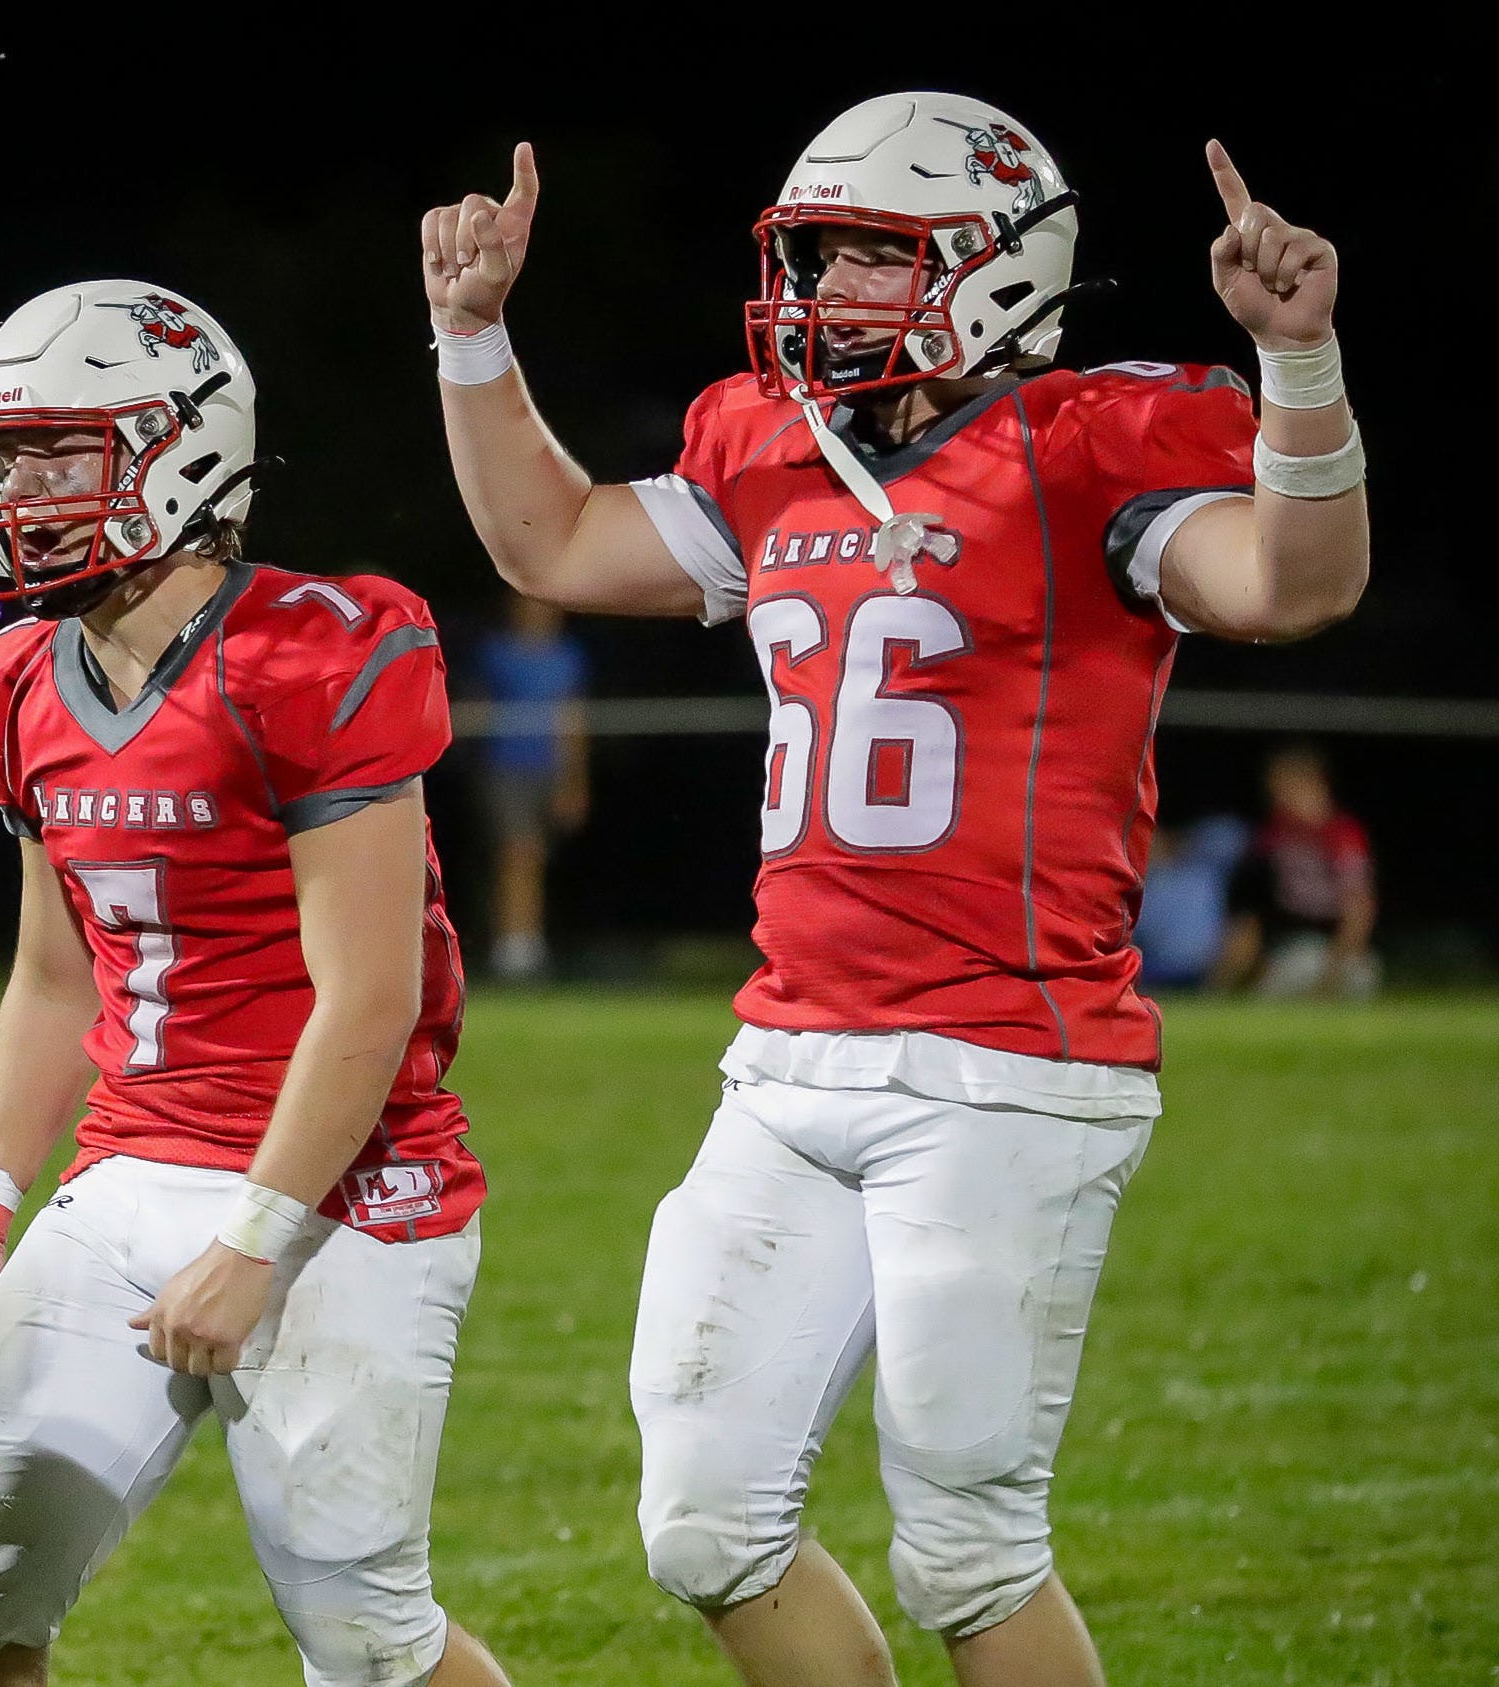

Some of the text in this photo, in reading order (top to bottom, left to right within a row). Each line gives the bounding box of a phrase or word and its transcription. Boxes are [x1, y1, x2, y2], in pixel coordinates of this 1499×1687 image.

[276, 580, 365, 624] 7
[749, 592, 973, 860] 66
[31, 785, 214, 824] LANCERS
[70, 860, 176, 1072] 7
